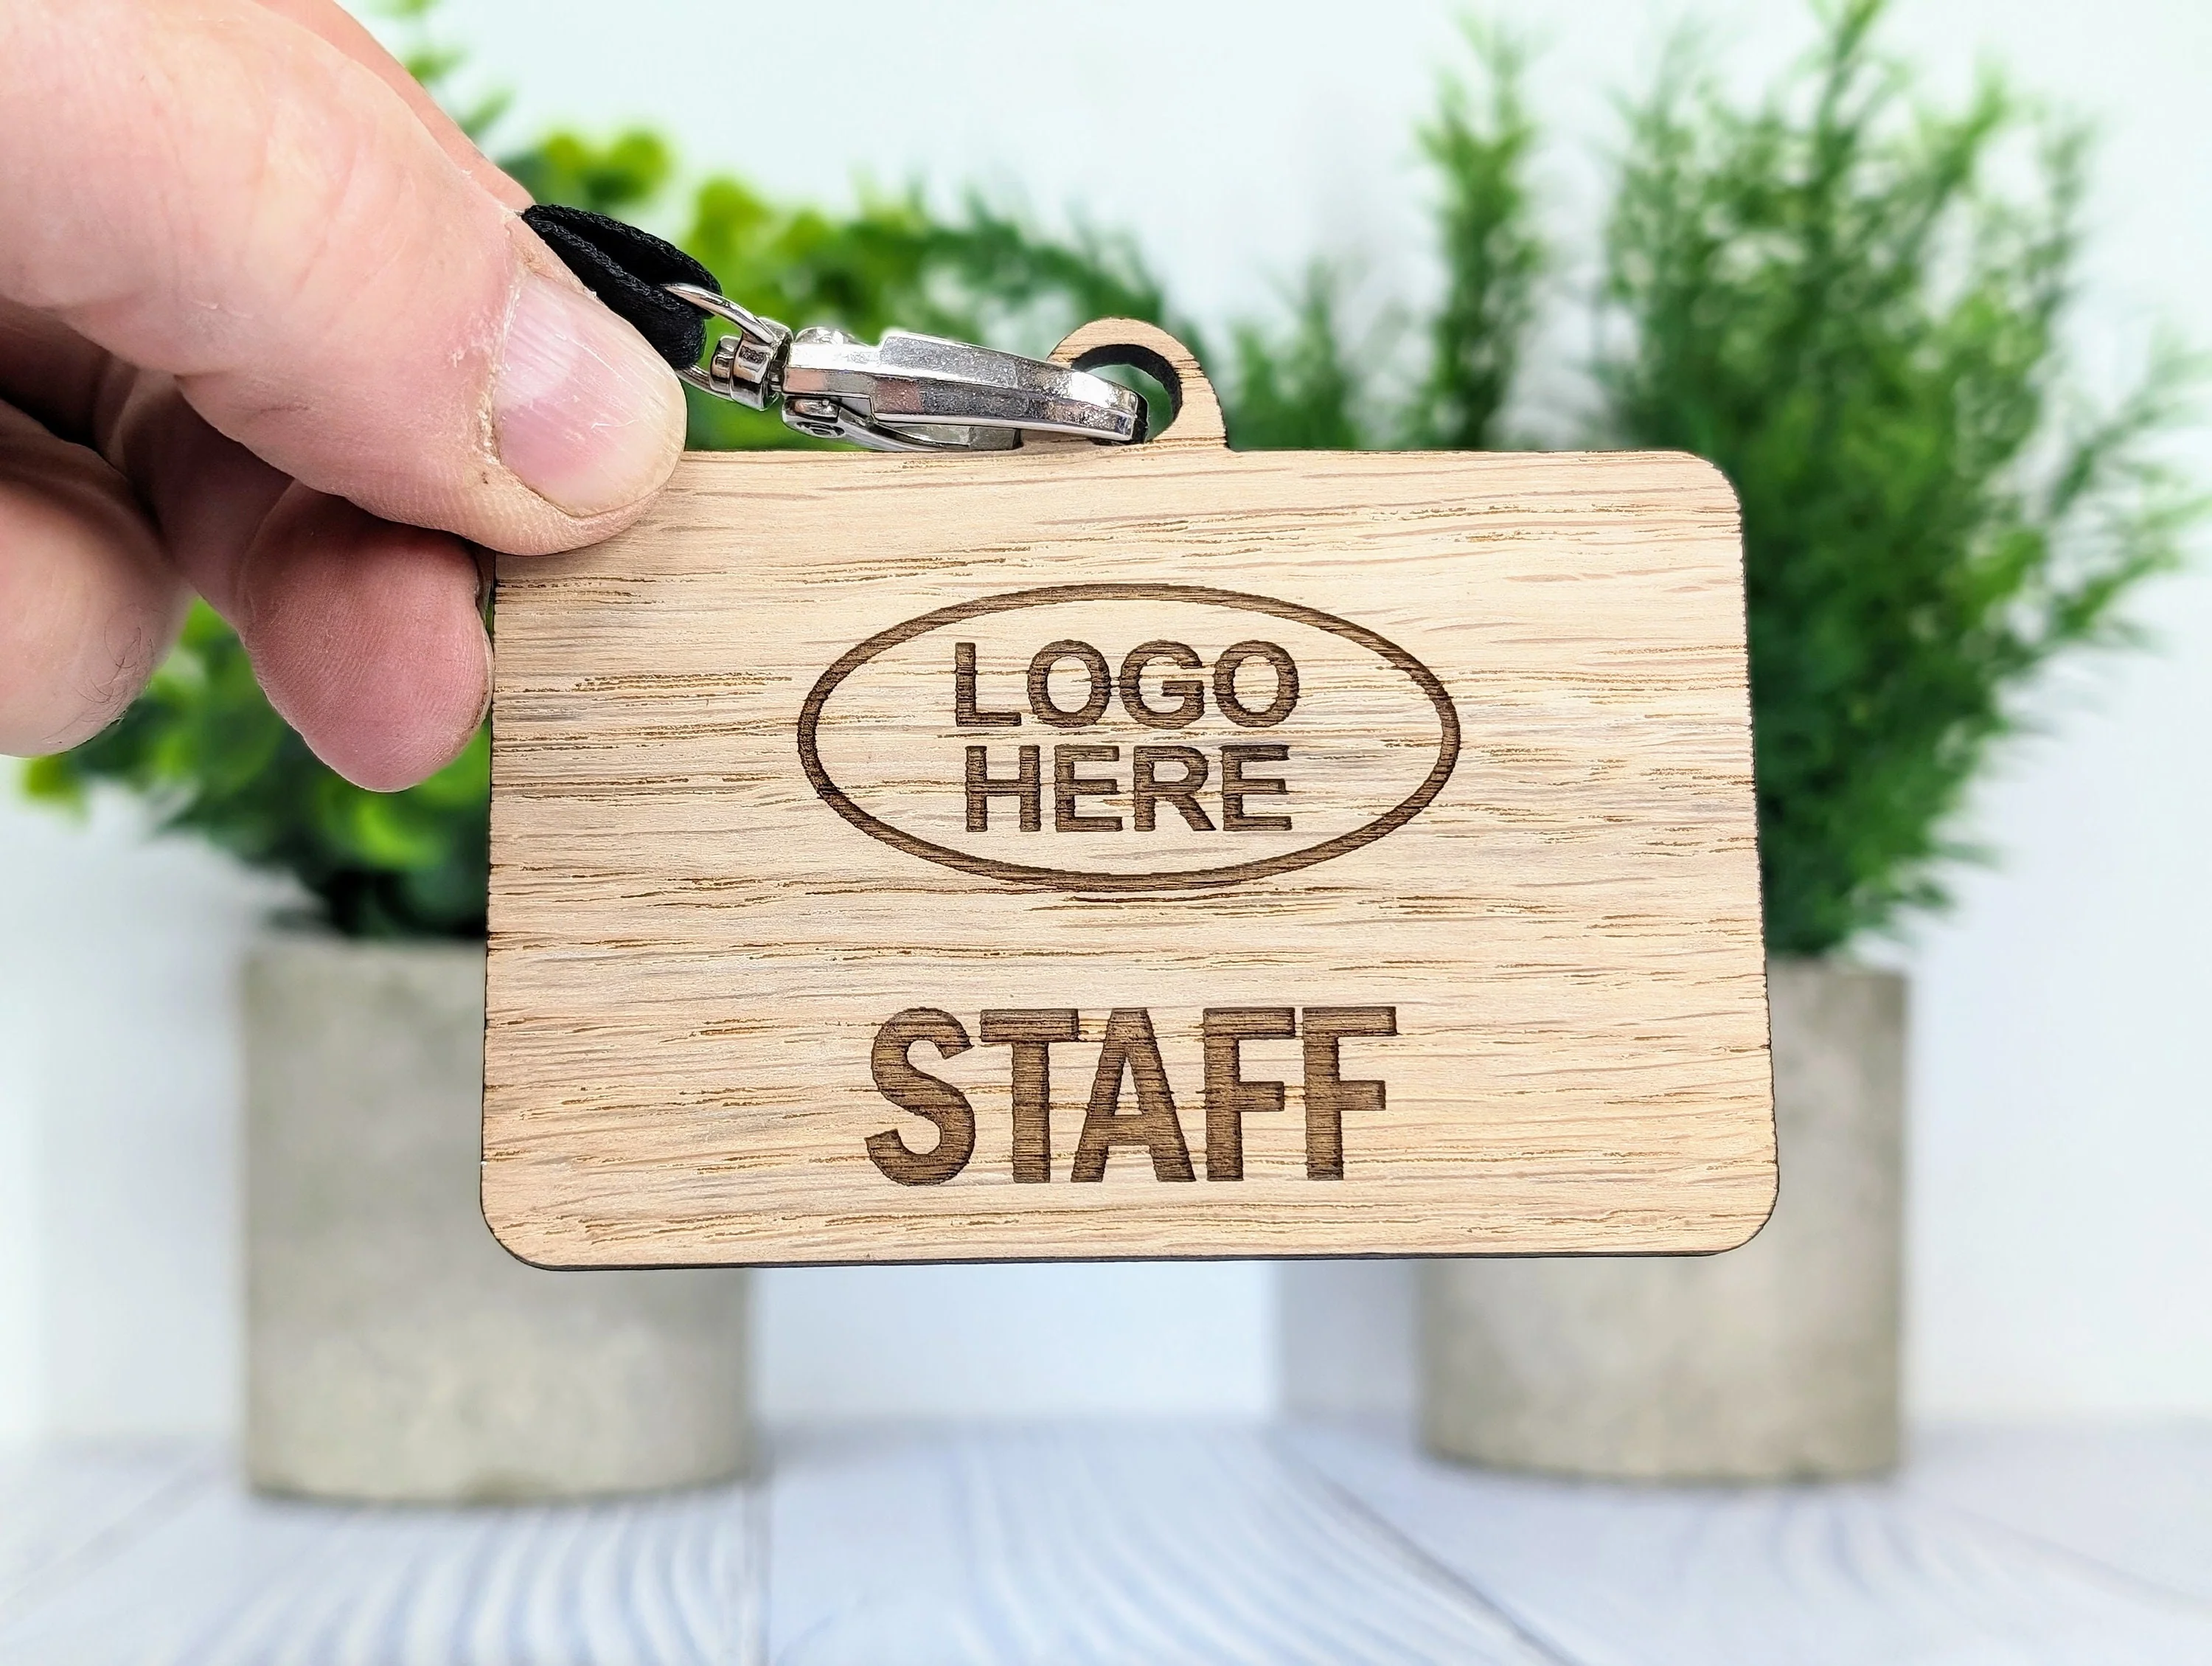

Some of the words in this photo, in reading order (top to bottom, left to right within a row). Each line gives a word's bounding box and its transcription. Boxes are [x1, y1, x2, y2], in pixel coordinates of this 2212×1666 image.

[954, 639, 1300, 729] LOGO
[964, 744, 1293, 833] HERE
[865, 1006, 1398, 1187] STAFF
